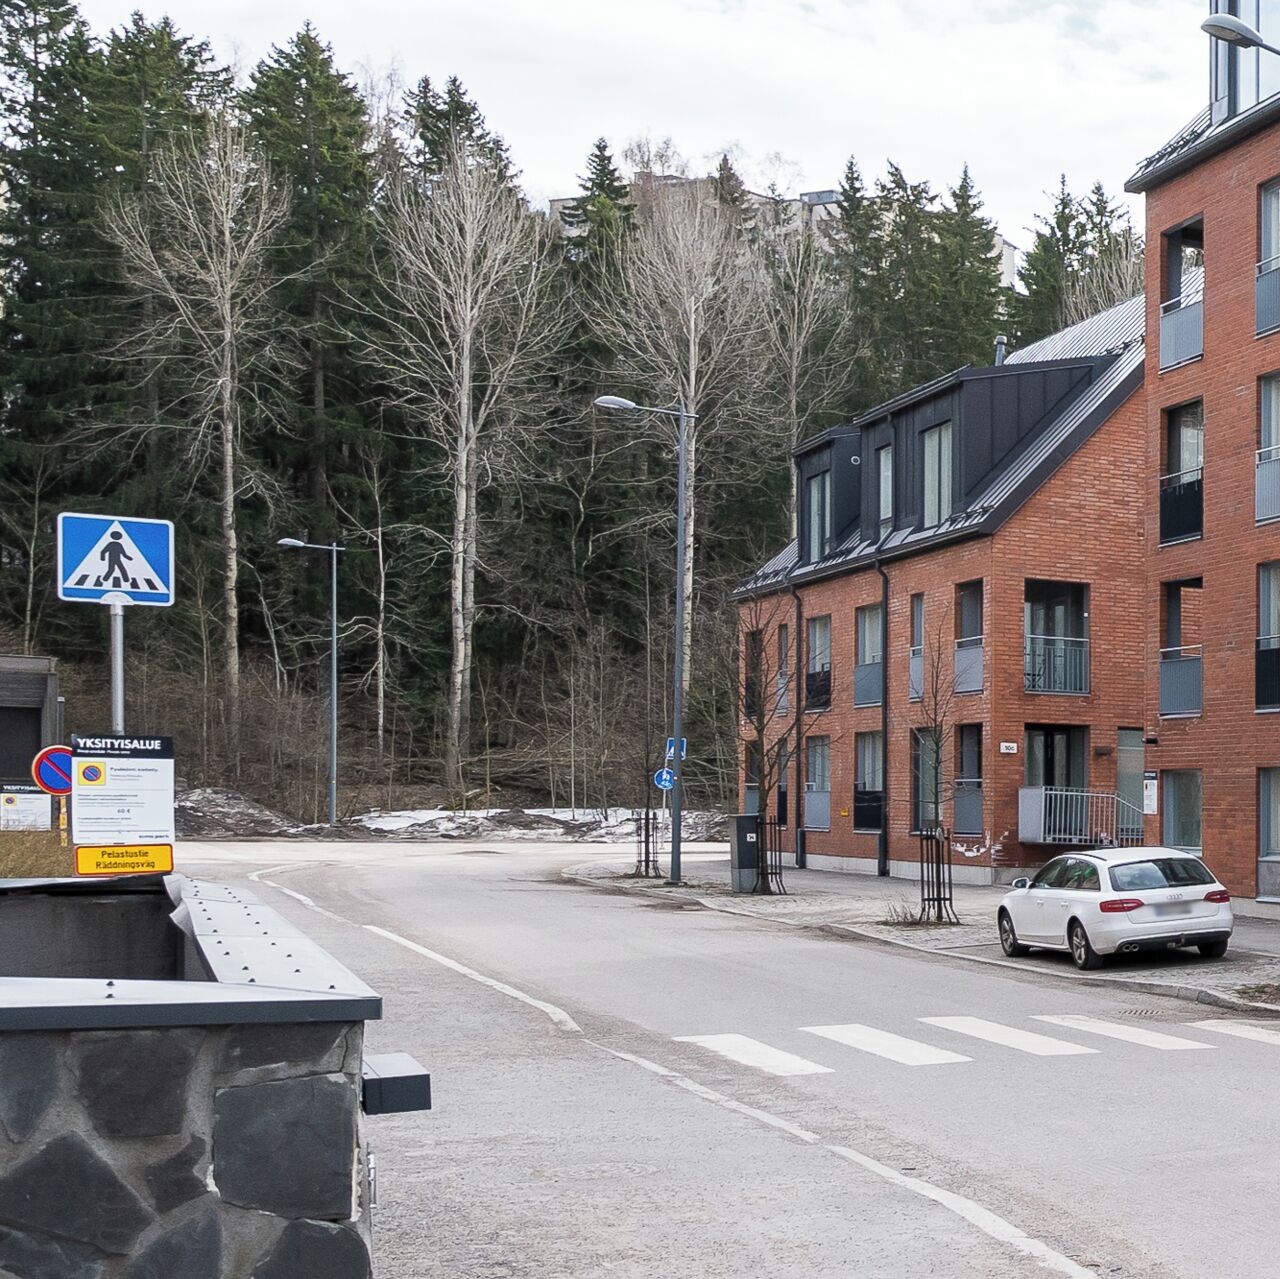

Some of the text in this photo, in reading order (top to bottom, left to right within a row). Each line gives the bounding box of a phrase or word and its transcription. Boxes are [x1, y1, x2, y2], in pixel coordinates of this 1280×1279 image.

[77, 738, 162, 750] YKSITYISALUE
[101, 850, 149, 859] Pelastustie
[96, 861, 155, 869] Räddningsväg
